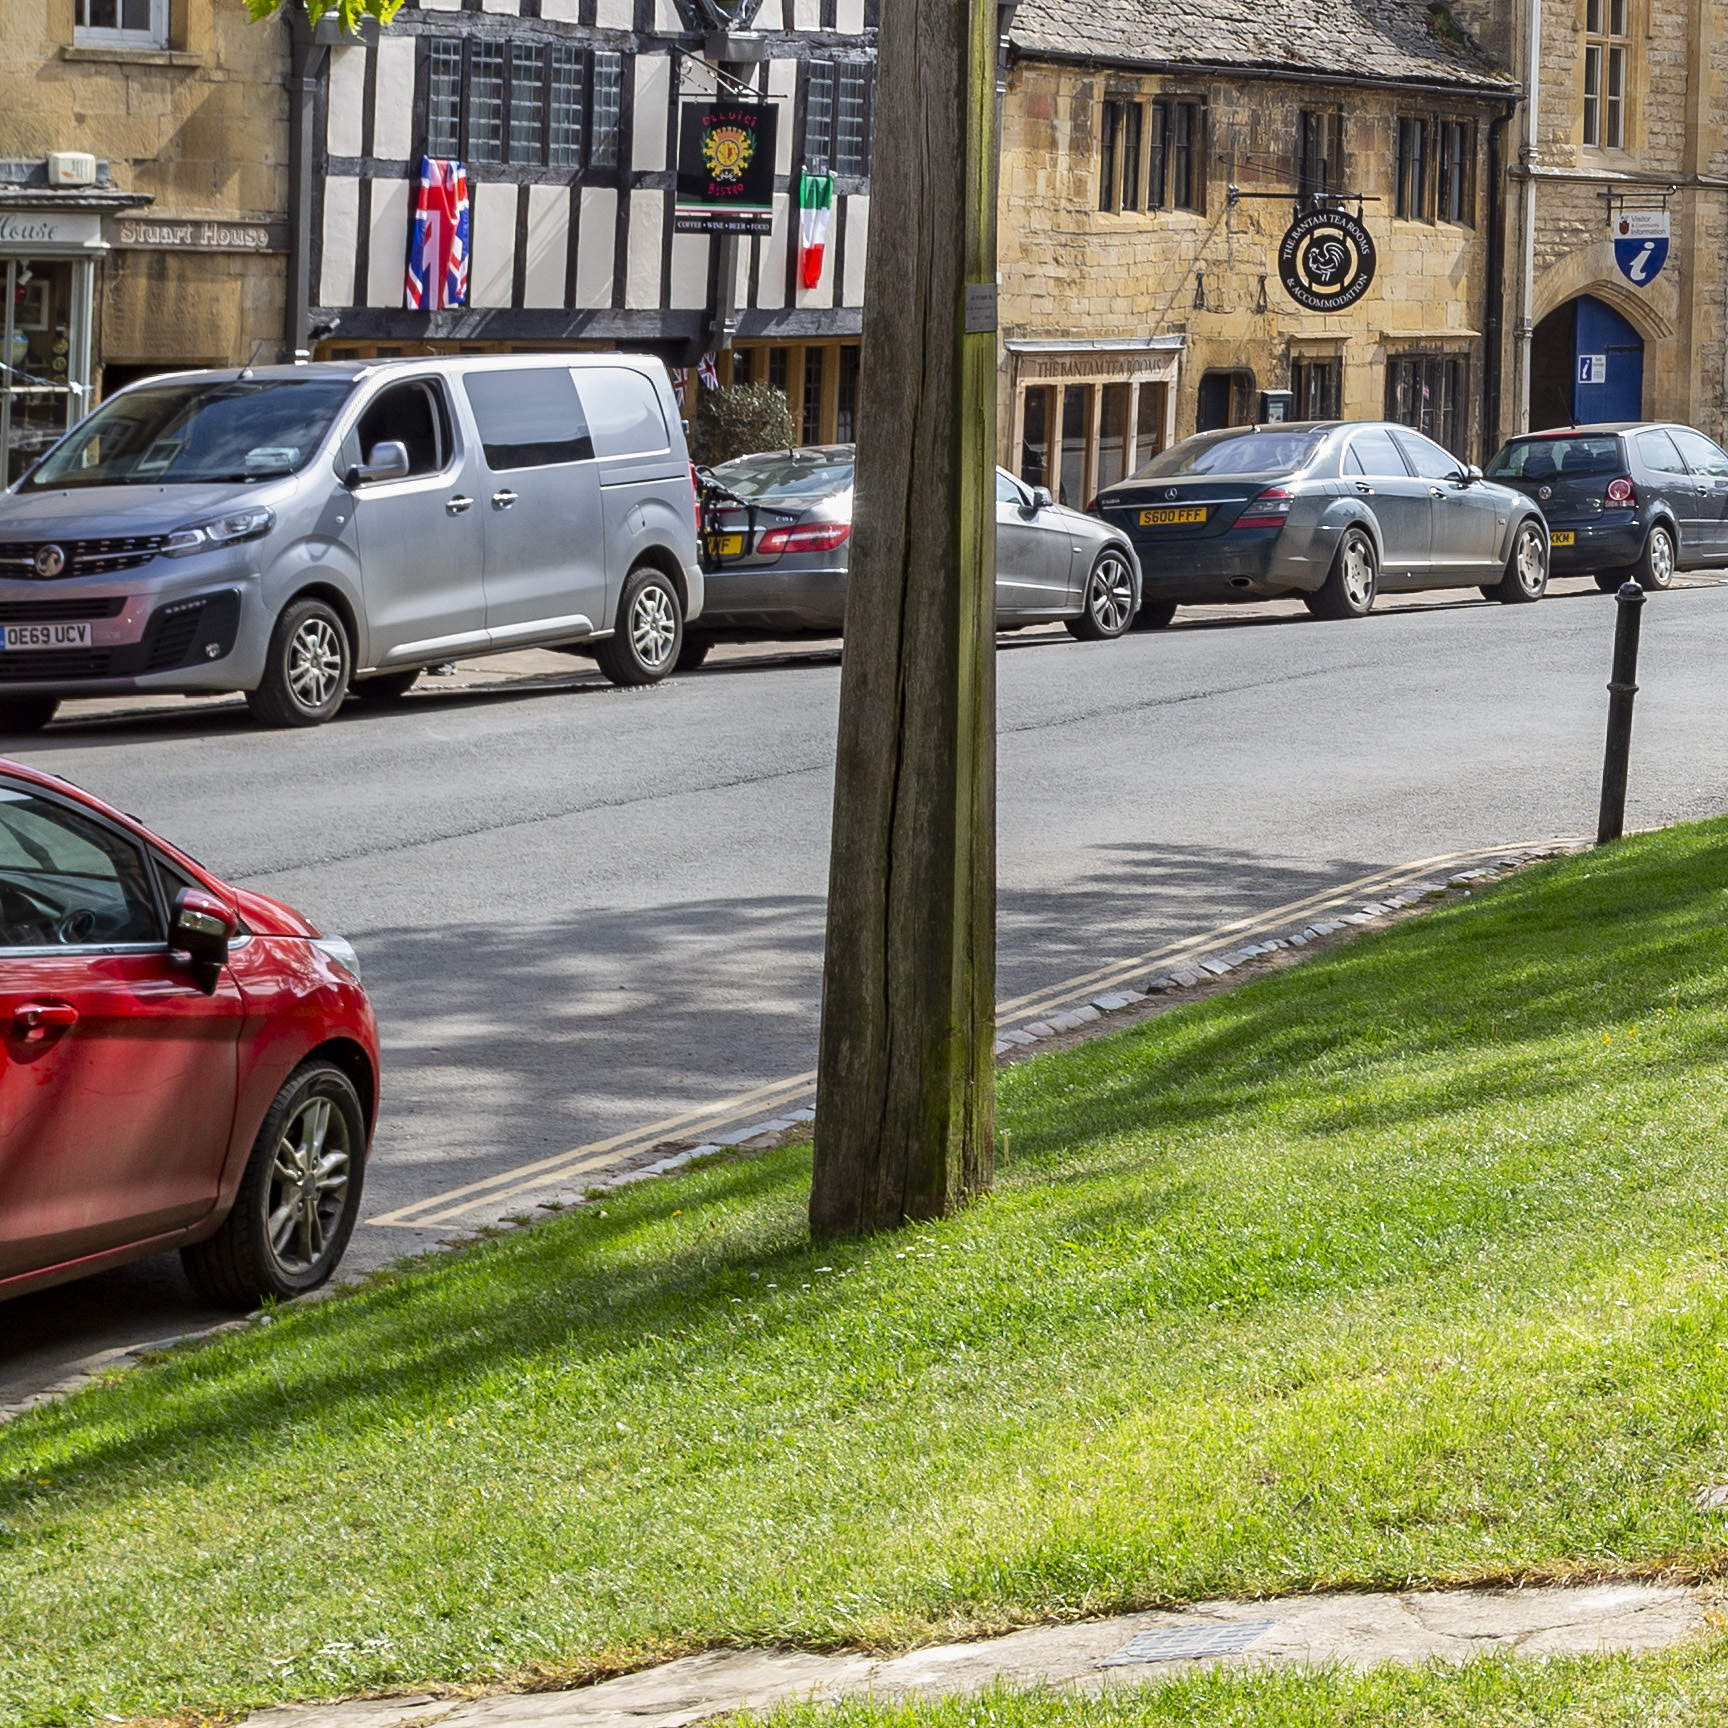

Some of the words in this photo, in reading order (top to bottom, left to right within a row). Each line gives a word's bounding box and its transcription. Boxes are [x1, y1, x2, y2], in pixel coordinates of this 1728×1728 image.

[121, 222, 192, 243] Stuart
[200, 223, 269, 246] House
[1283, 238, 1296, 260] THE
[1292, 214, 1327, 239] BANTAM
[1328, 214, 1346, 227] TEA
[1346, 222, 1370, 255] ROOMS
[1286, 278, 1296, 287] &
[1292, 273, 1368, 308] ACCOMMODATION
[1038, 361, 1059, 377] THE
[1060, 359, 1104, 377] BANTAM
[1126, 358, 1161, 375] ROOMS
[1144, 511, 1175, 523] S600
[1178, 509, 1202, 521] FFF
[7, 626, 50, 645] OE69
[55, 625, 86, 643] UCV
